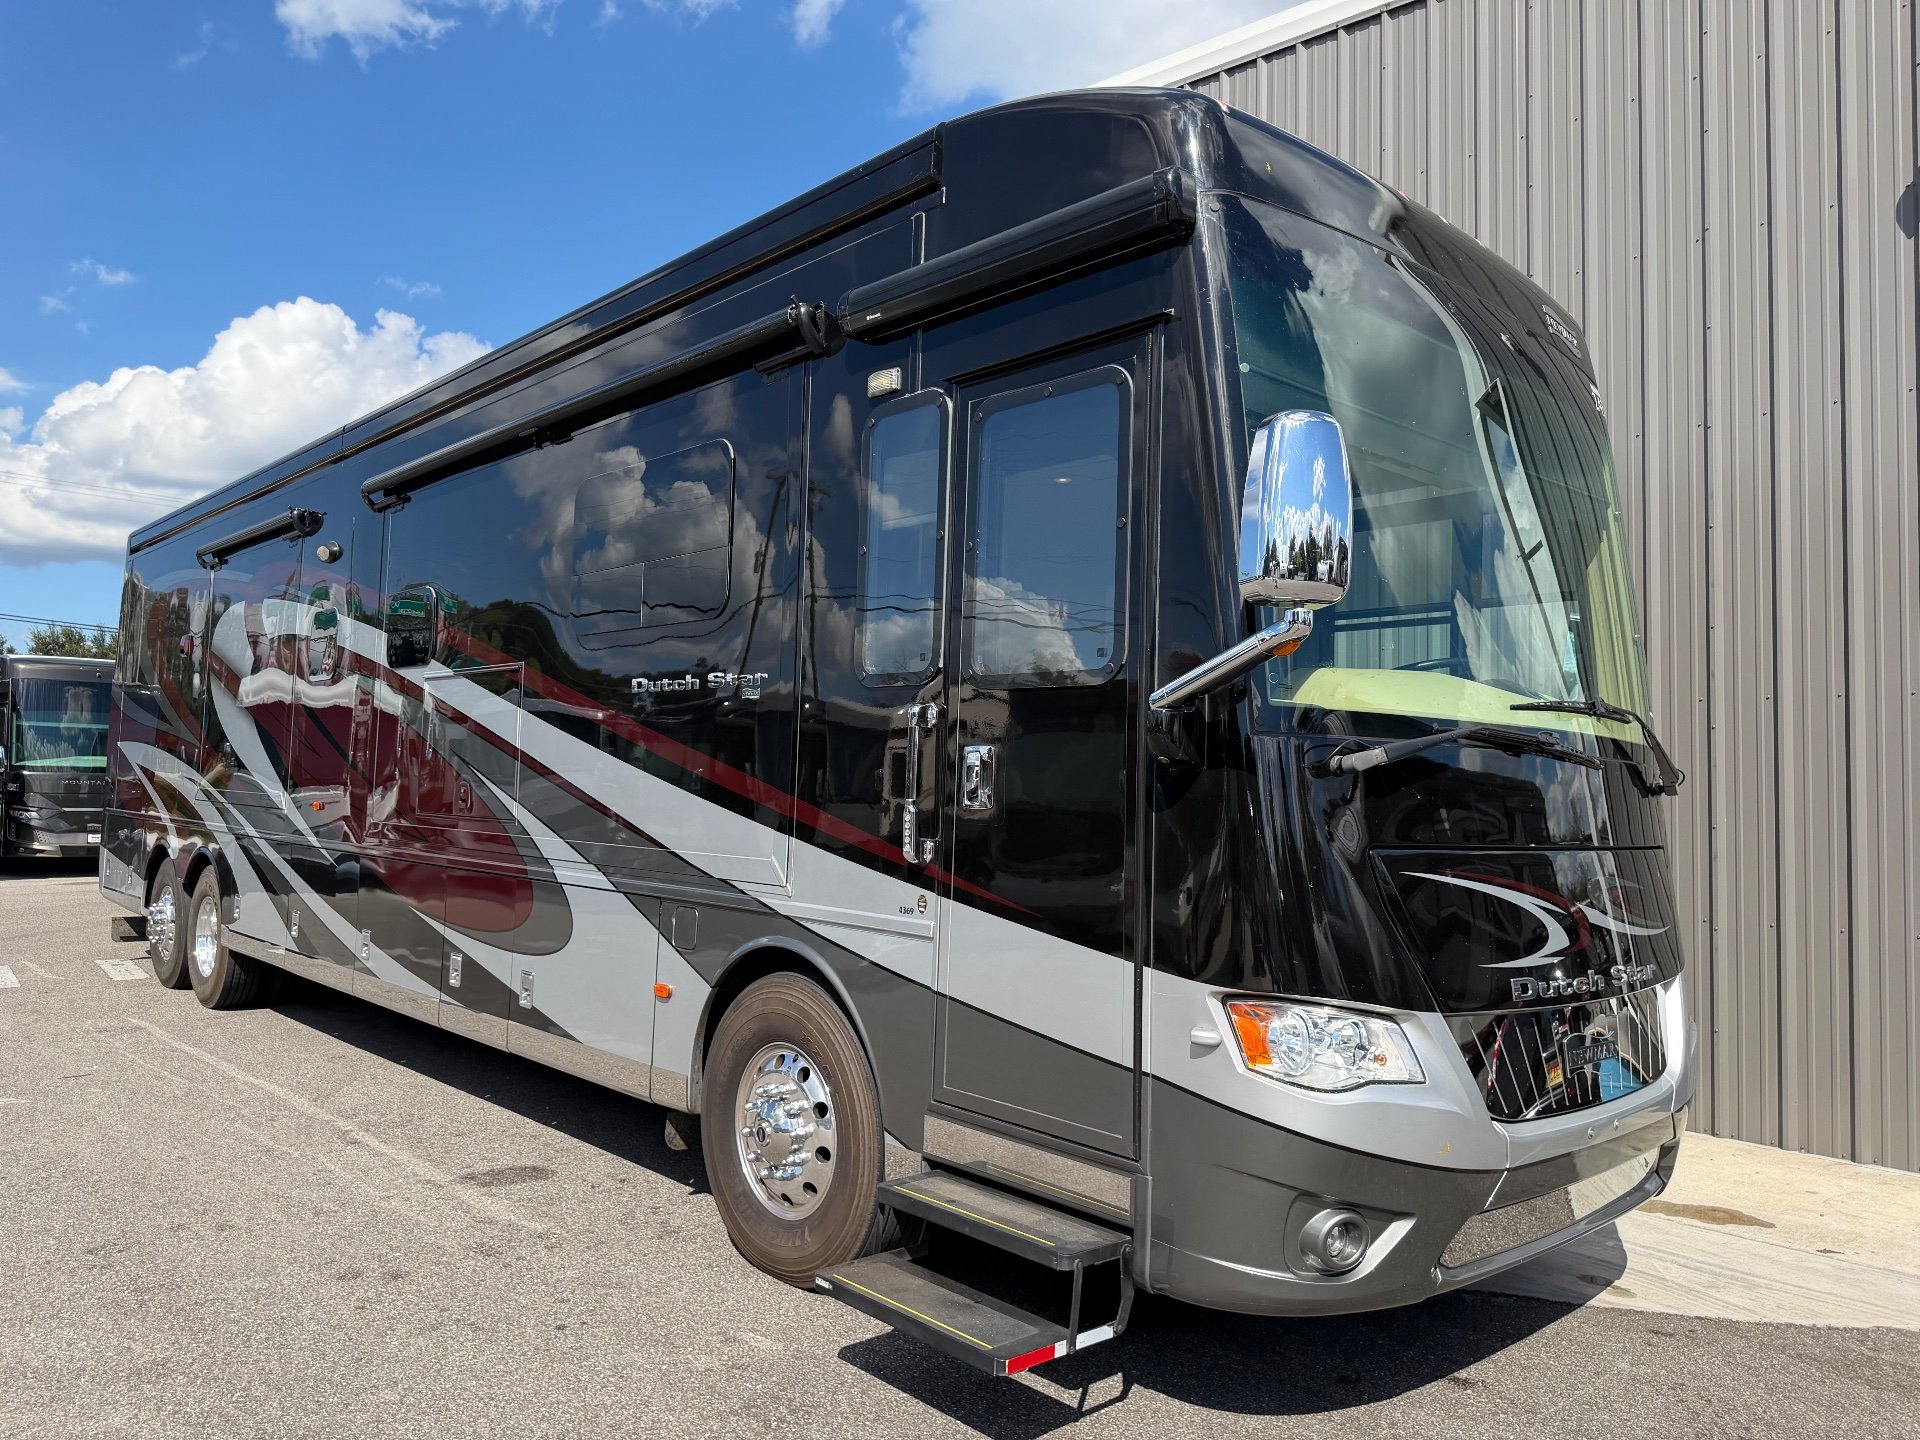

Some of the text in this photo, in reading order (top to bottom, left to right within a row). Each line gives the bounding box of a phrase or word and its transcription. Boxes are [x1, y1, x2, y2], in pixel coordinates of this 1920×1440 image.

[631, 672, 768, 693] Dutch Star
[898, 906, 915, 915] 4369
[1511, 964, 1657, 1001] Dutch Star
[1568, 1042, 1617, 1067] NEWMAR
